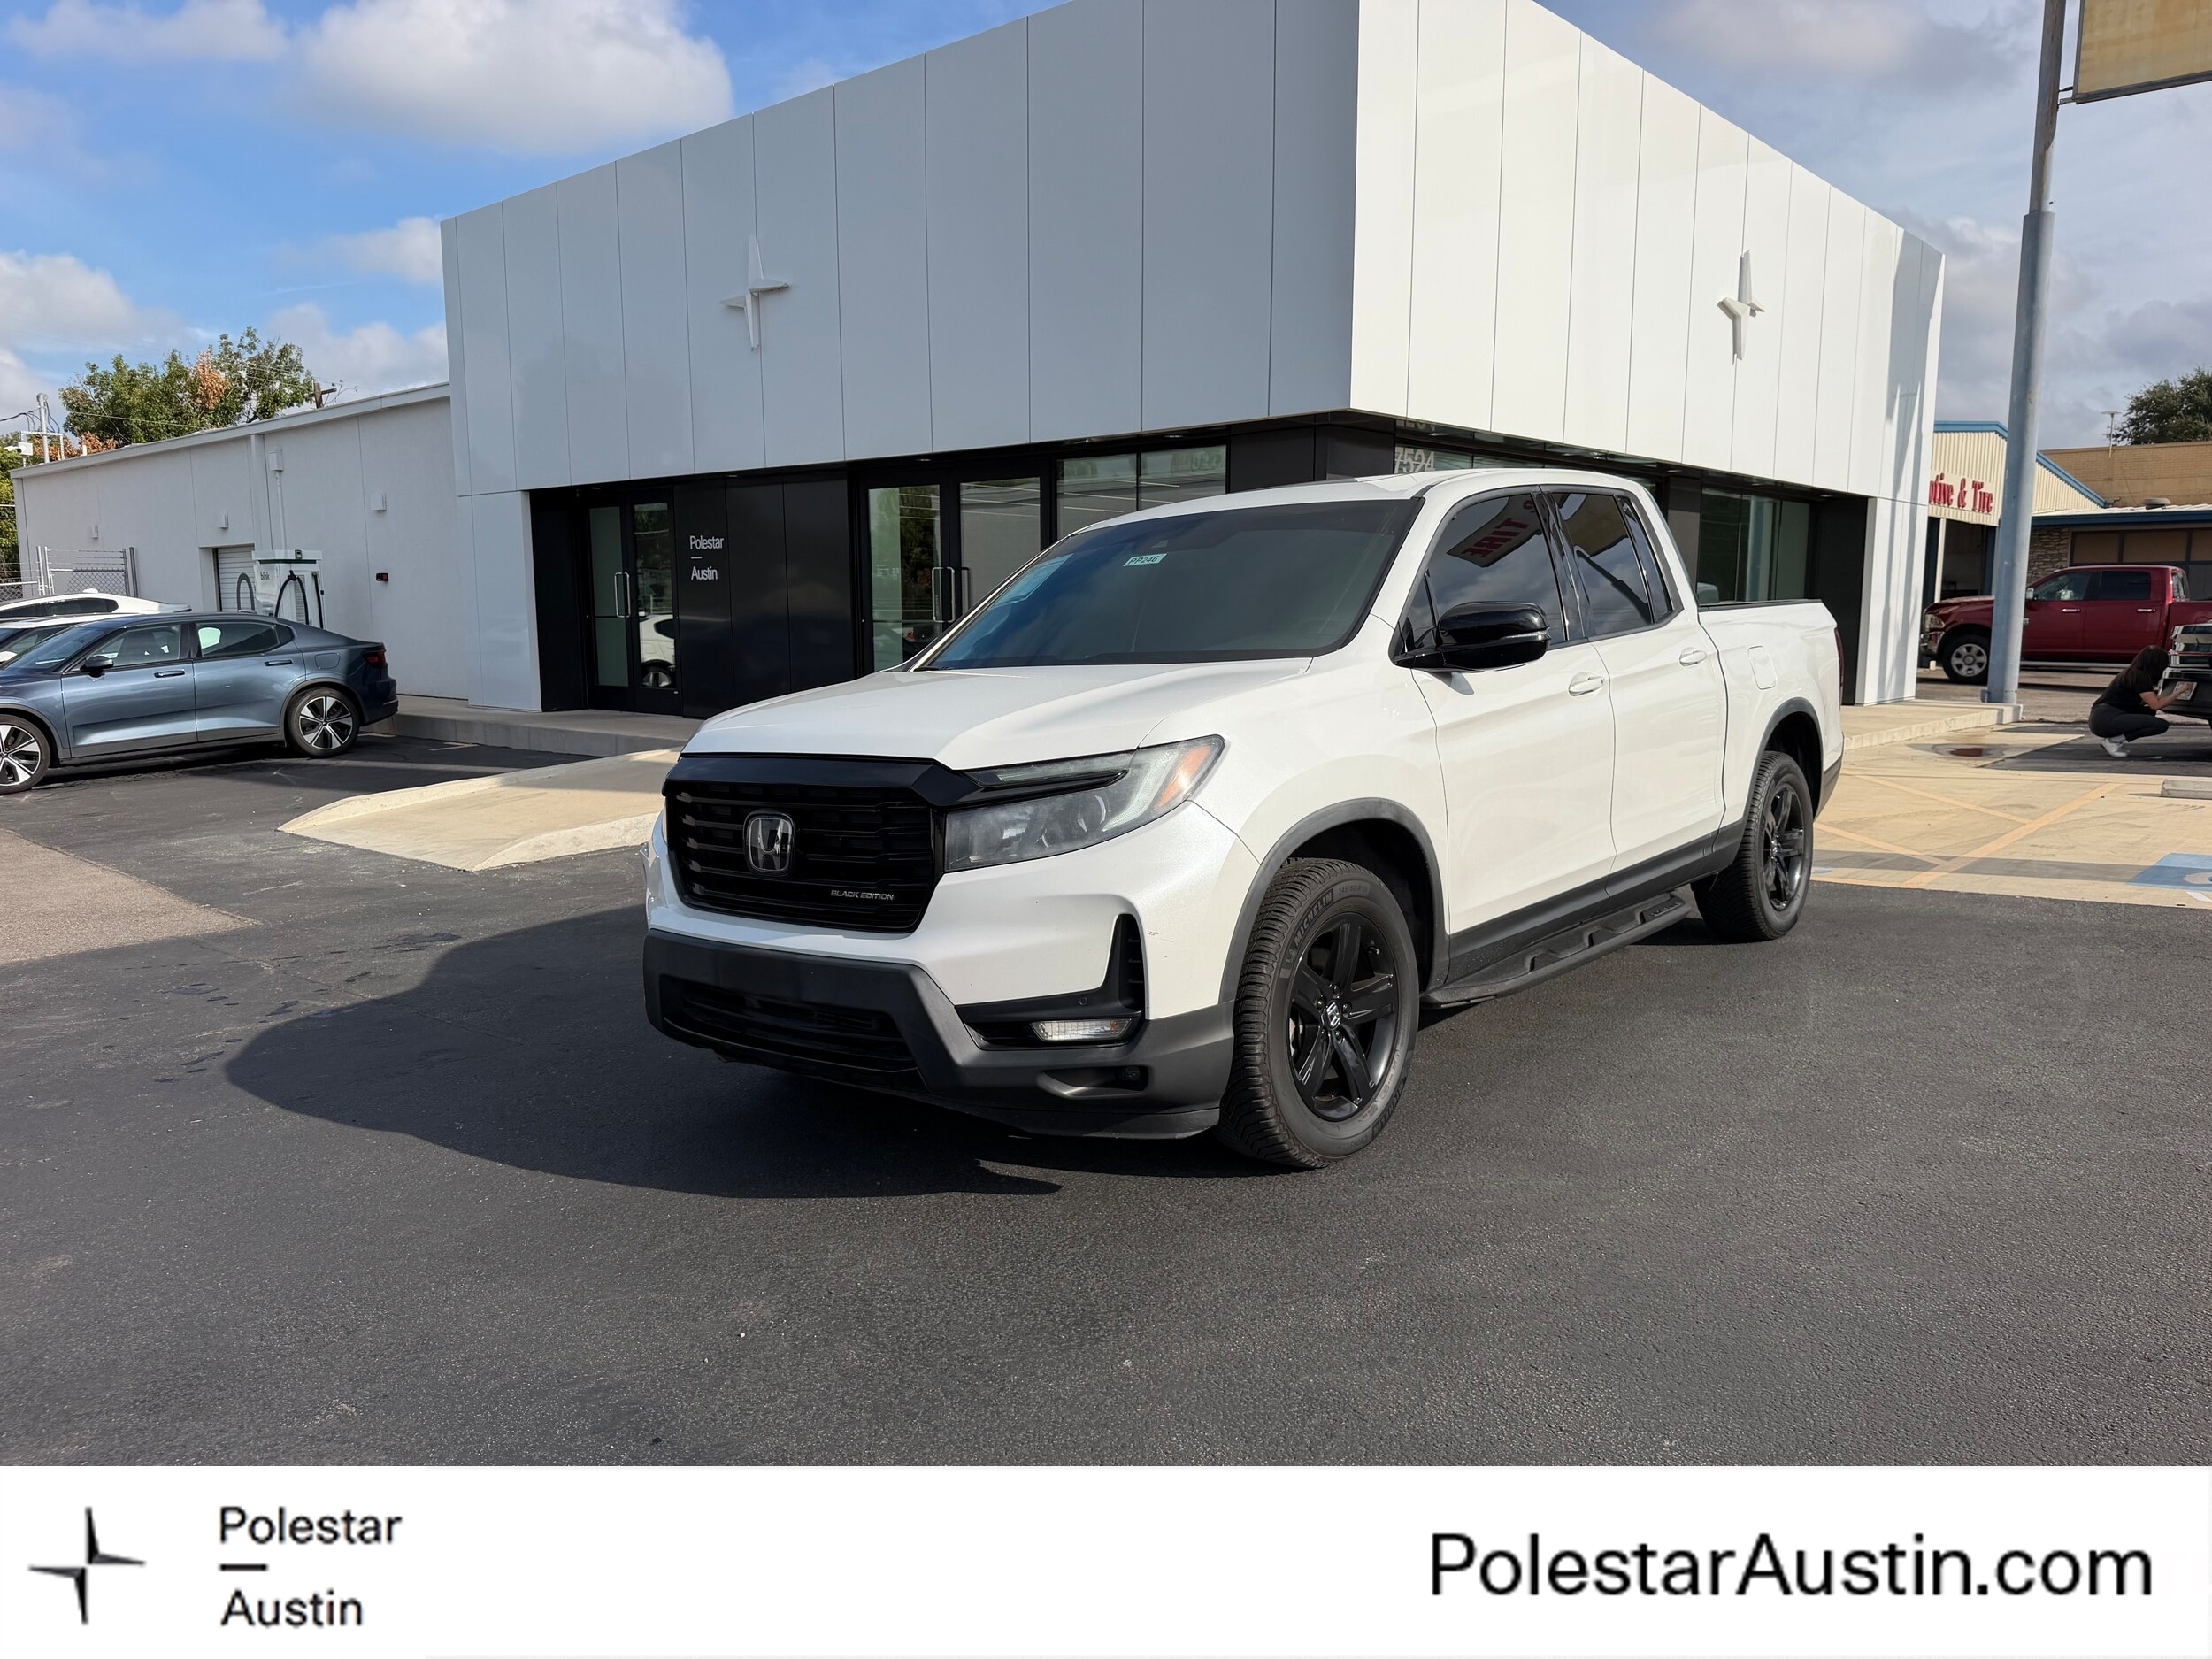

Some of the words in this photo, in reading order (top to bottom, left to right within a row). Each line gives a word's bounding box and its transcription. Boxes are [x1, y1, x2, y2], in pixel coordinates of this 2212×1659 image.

[1394, 446, 1435, 473] 7524
[1957, 478, 1967, 508] &
[1971, 480, 1993, 513] Tire
[690, 535, 724, 549] Polestar
[1127, 555, 1160, 565] PP246
[691, 566, 718, 580] Austin
[831, 889, 858, 898] BLACK
[860, 892, 895, 901] EDITION
[1294, 890, 1333, 947] MICHELIN
